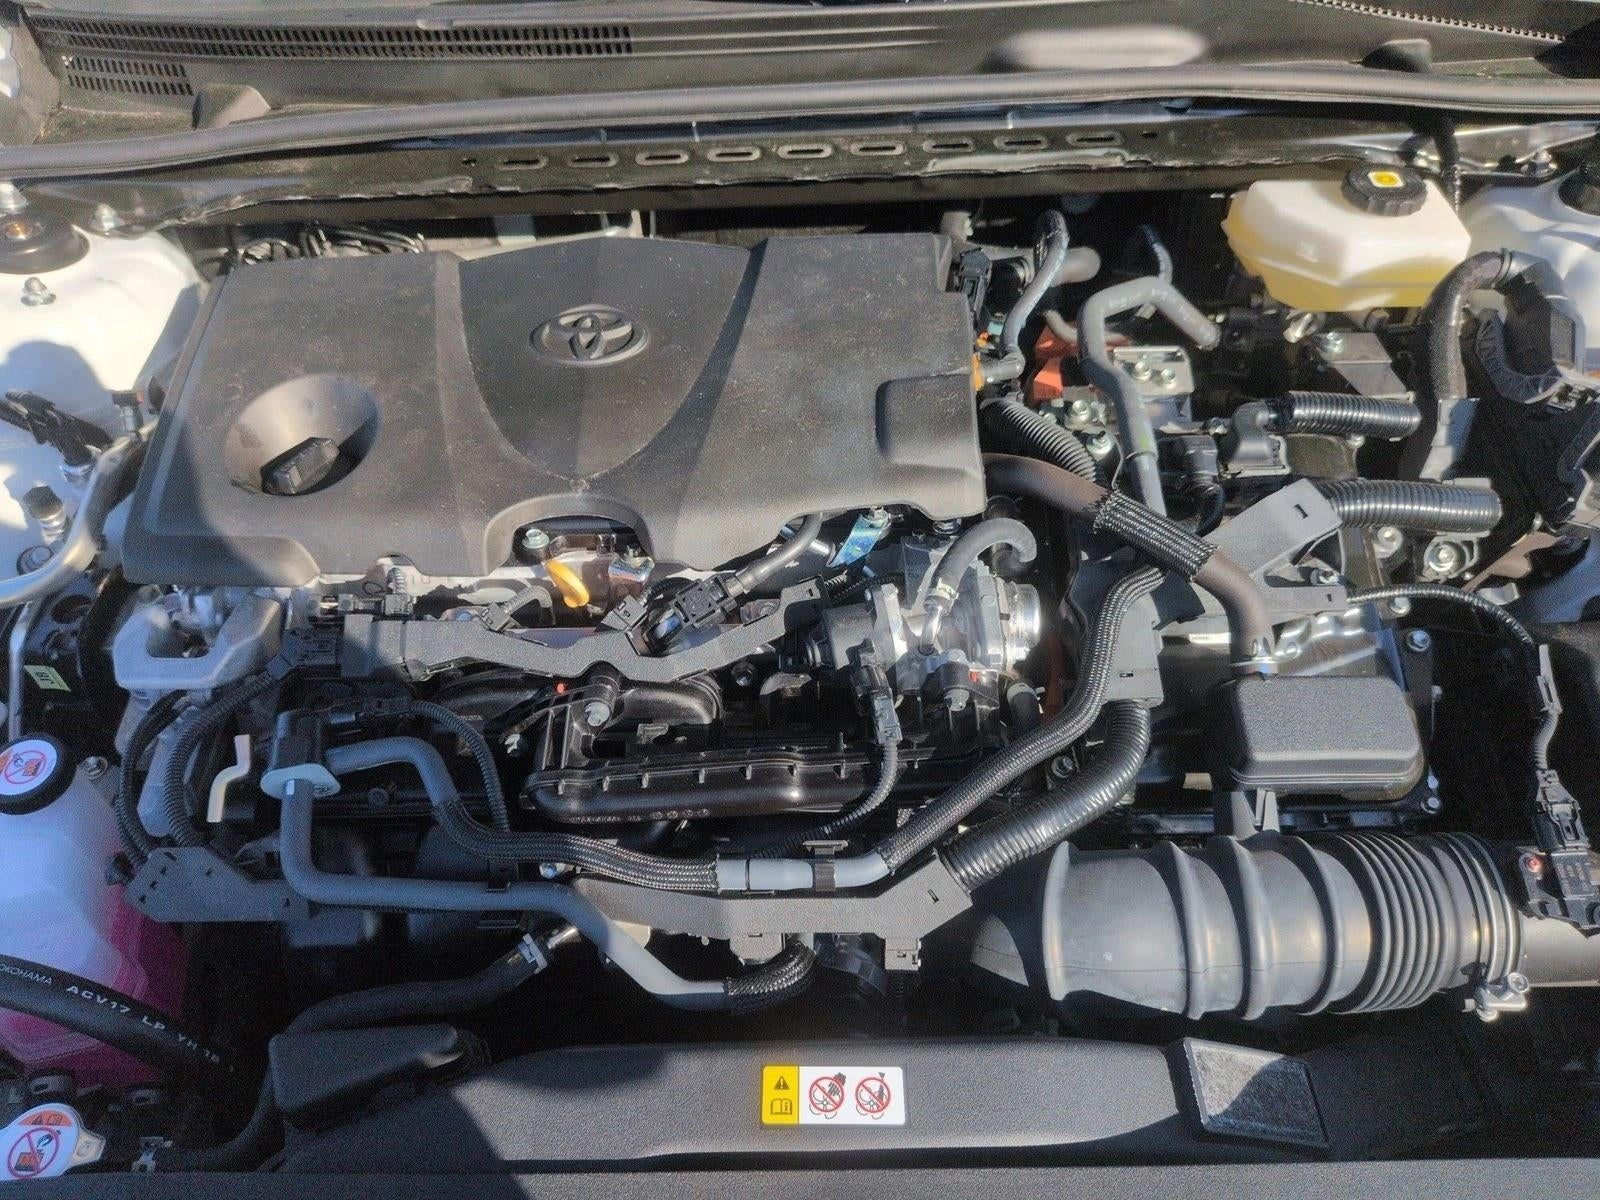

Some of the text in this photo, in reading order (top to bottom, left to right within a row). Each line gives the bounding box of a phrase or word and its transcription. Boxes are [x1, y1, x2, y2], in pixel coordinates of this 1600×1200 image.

[0, 963, 52, 985] OKOHAMA
[66, 985, 131, 1013] ACV17
[142, 1015, 165, 1030] LP
[178, 1033, 198, 1050] YH
